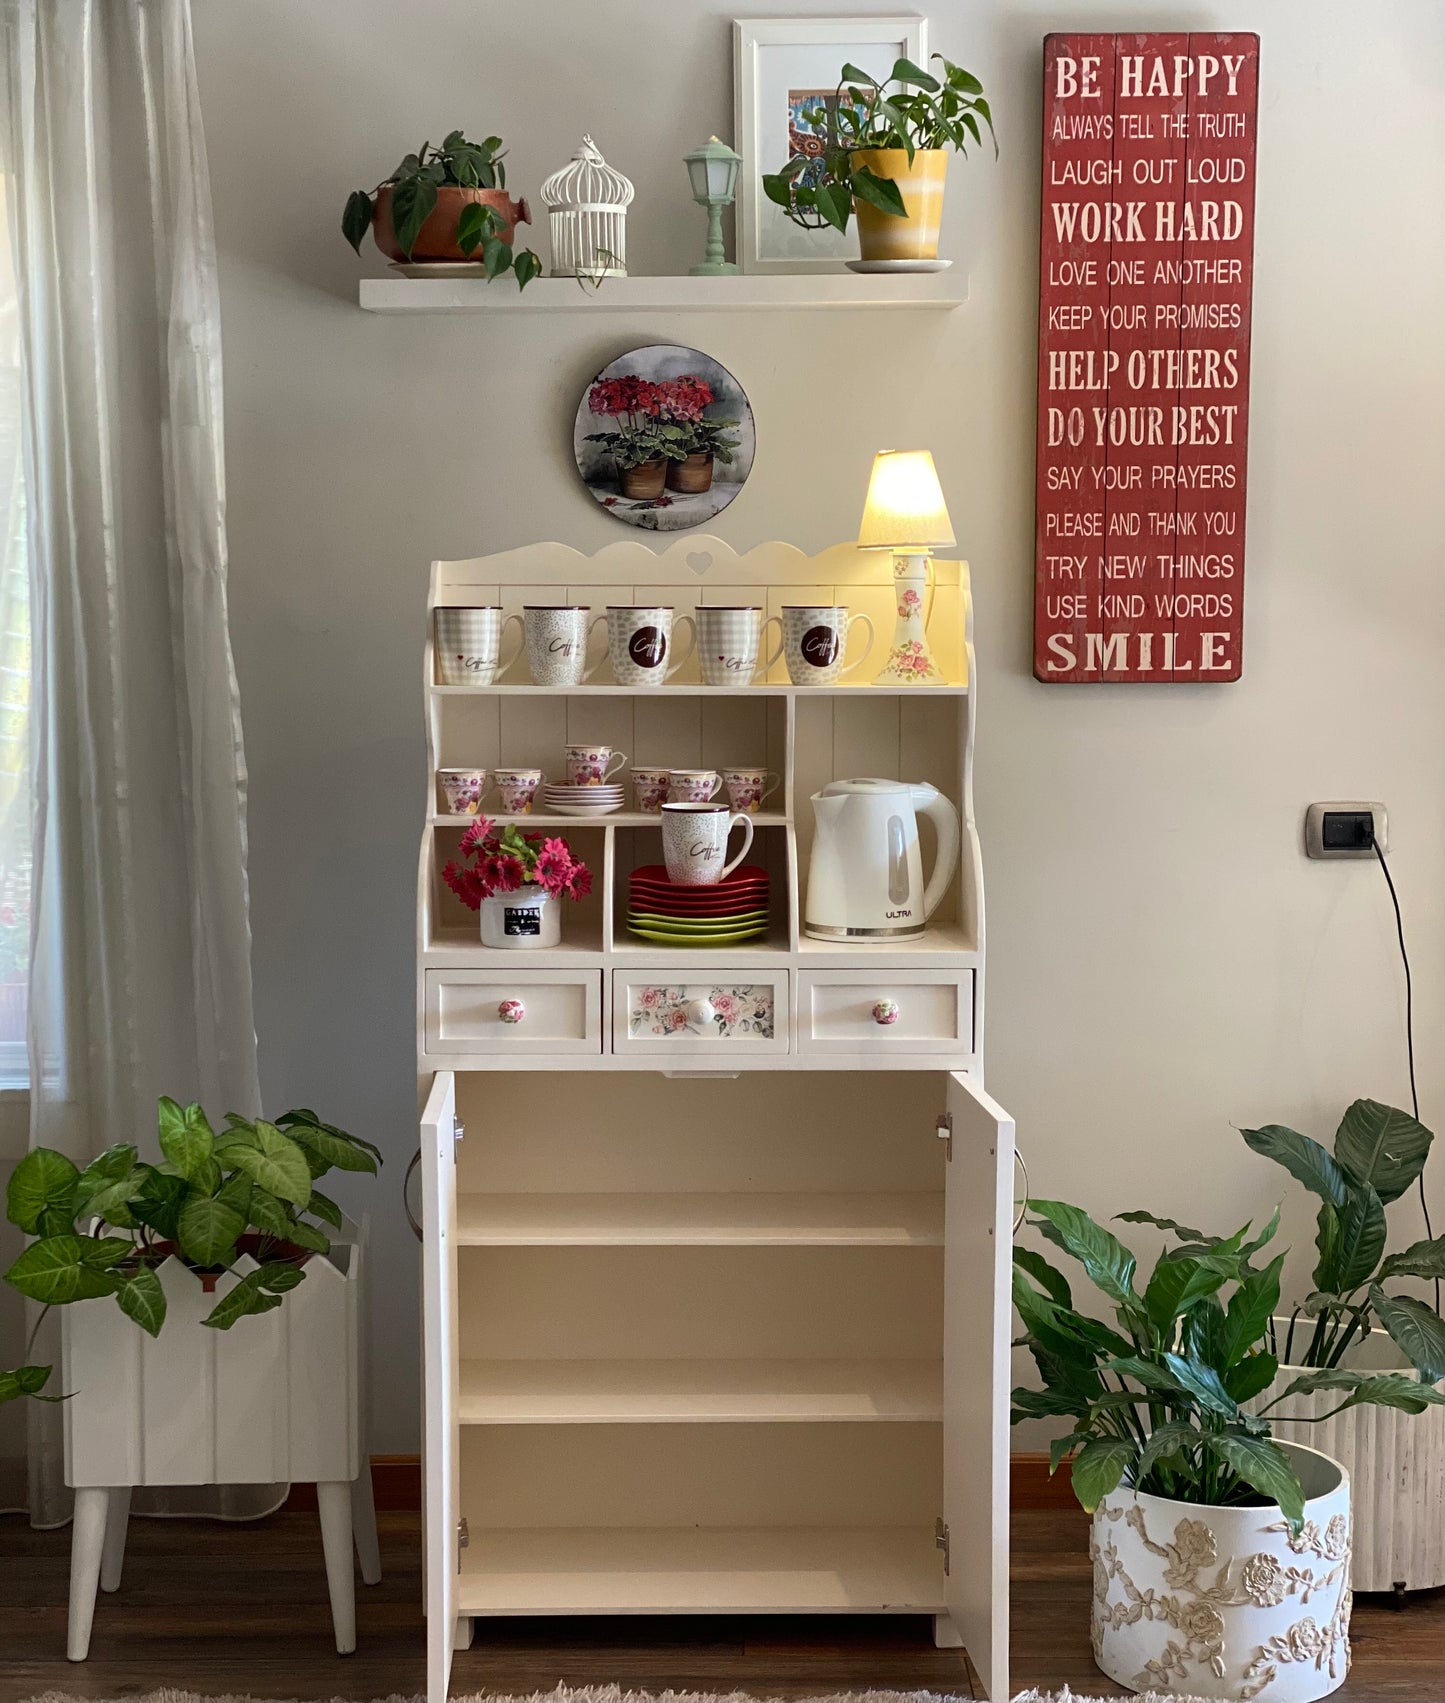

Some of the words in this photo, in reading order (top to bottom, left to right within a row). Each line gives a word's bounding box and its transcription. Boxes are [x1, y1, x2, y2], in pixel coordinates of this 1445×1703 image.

[1055, 56, 1101, 98] BE
[1120, 55, 1245, 97] HAPPY
[1052, 114, 1114, 139] ALWAYS
[1120, 114, 1154, 139] TELL
[1161, 114, 1189, 138] THE
[1197, 112, 1245, 138] TRUTH
[1051, 159, 1122, 185] LAUGH
[1133, 159, 1177, 184] OUT
[1188, 158, 1245, 183] LOUD
[1051, 201, 1147, 243] WORK
[1154, 200, 1243, 241] HARD
[1050, 261, 1098, 286] LOVE
[1107, 260, 1145, 285] ONE
[1153, 259, 1242, 284] ANOTHER
[1049, 306, 1092, 330] KEEP
[1100, 305, 1147, 329] YOUR
[1156, 303, 1241, 329] PROMISES
[1048, 350, 1120, 391] HELP
[1127, 348, 1239, 389] OTHERS
[1047, 407, 1085, 447] DO
[1092, 406, 1164, 447] YOUR
[1171, 405, 1238, 445] BEST
[1047, 466, 1083, 490] SAY
[1091, 465, 1142, 489] YOUR
[1152, 464, 1236, 489] PRAYERS
[1046, 513, 1102, 537] PLEASE
[1109, 512, 1141, 536] AND
[1148, 512, 1197, 536] THANK
[1203, 511, 1235, 535] YOU
[1046, 555, 1088, 580] TRY
[1098, 555, 1146, 579] NEW
[1156, 554, 1234, 578] THINGS
[1046, 595, 1087, 619] USE
[1098, 594, 1145, 618] KIND
[1155, 593, 1232, 617] WORDS
[1047, 631, 1232, 672] SMILE
[886, 910, 912, 918] ULTRA
